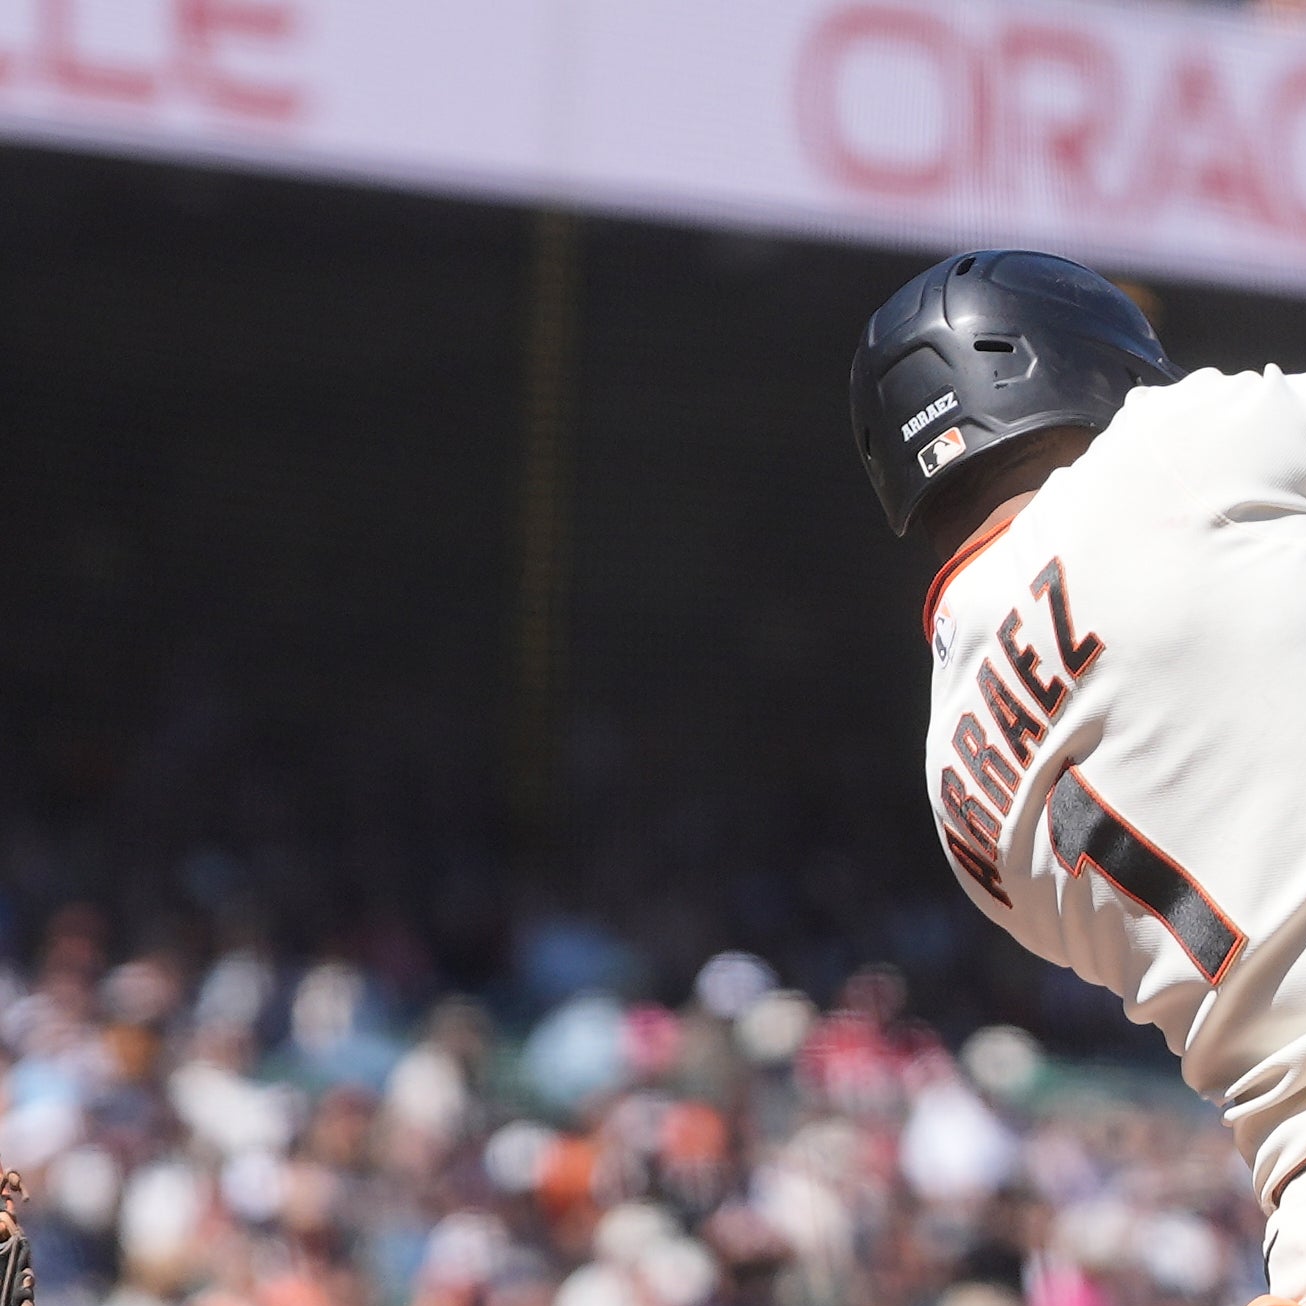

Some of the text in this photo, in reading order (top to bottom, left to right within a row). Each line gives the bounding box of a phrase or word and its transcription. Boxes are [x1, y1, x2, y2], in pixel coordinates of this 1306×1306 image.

[0, 0, 302, 124] LE
[901, 391, 959, 442] ARRAEZ
[940, 556, 1106, 909] ARRAEZ
[1047, 757, 1250, 986] 1
